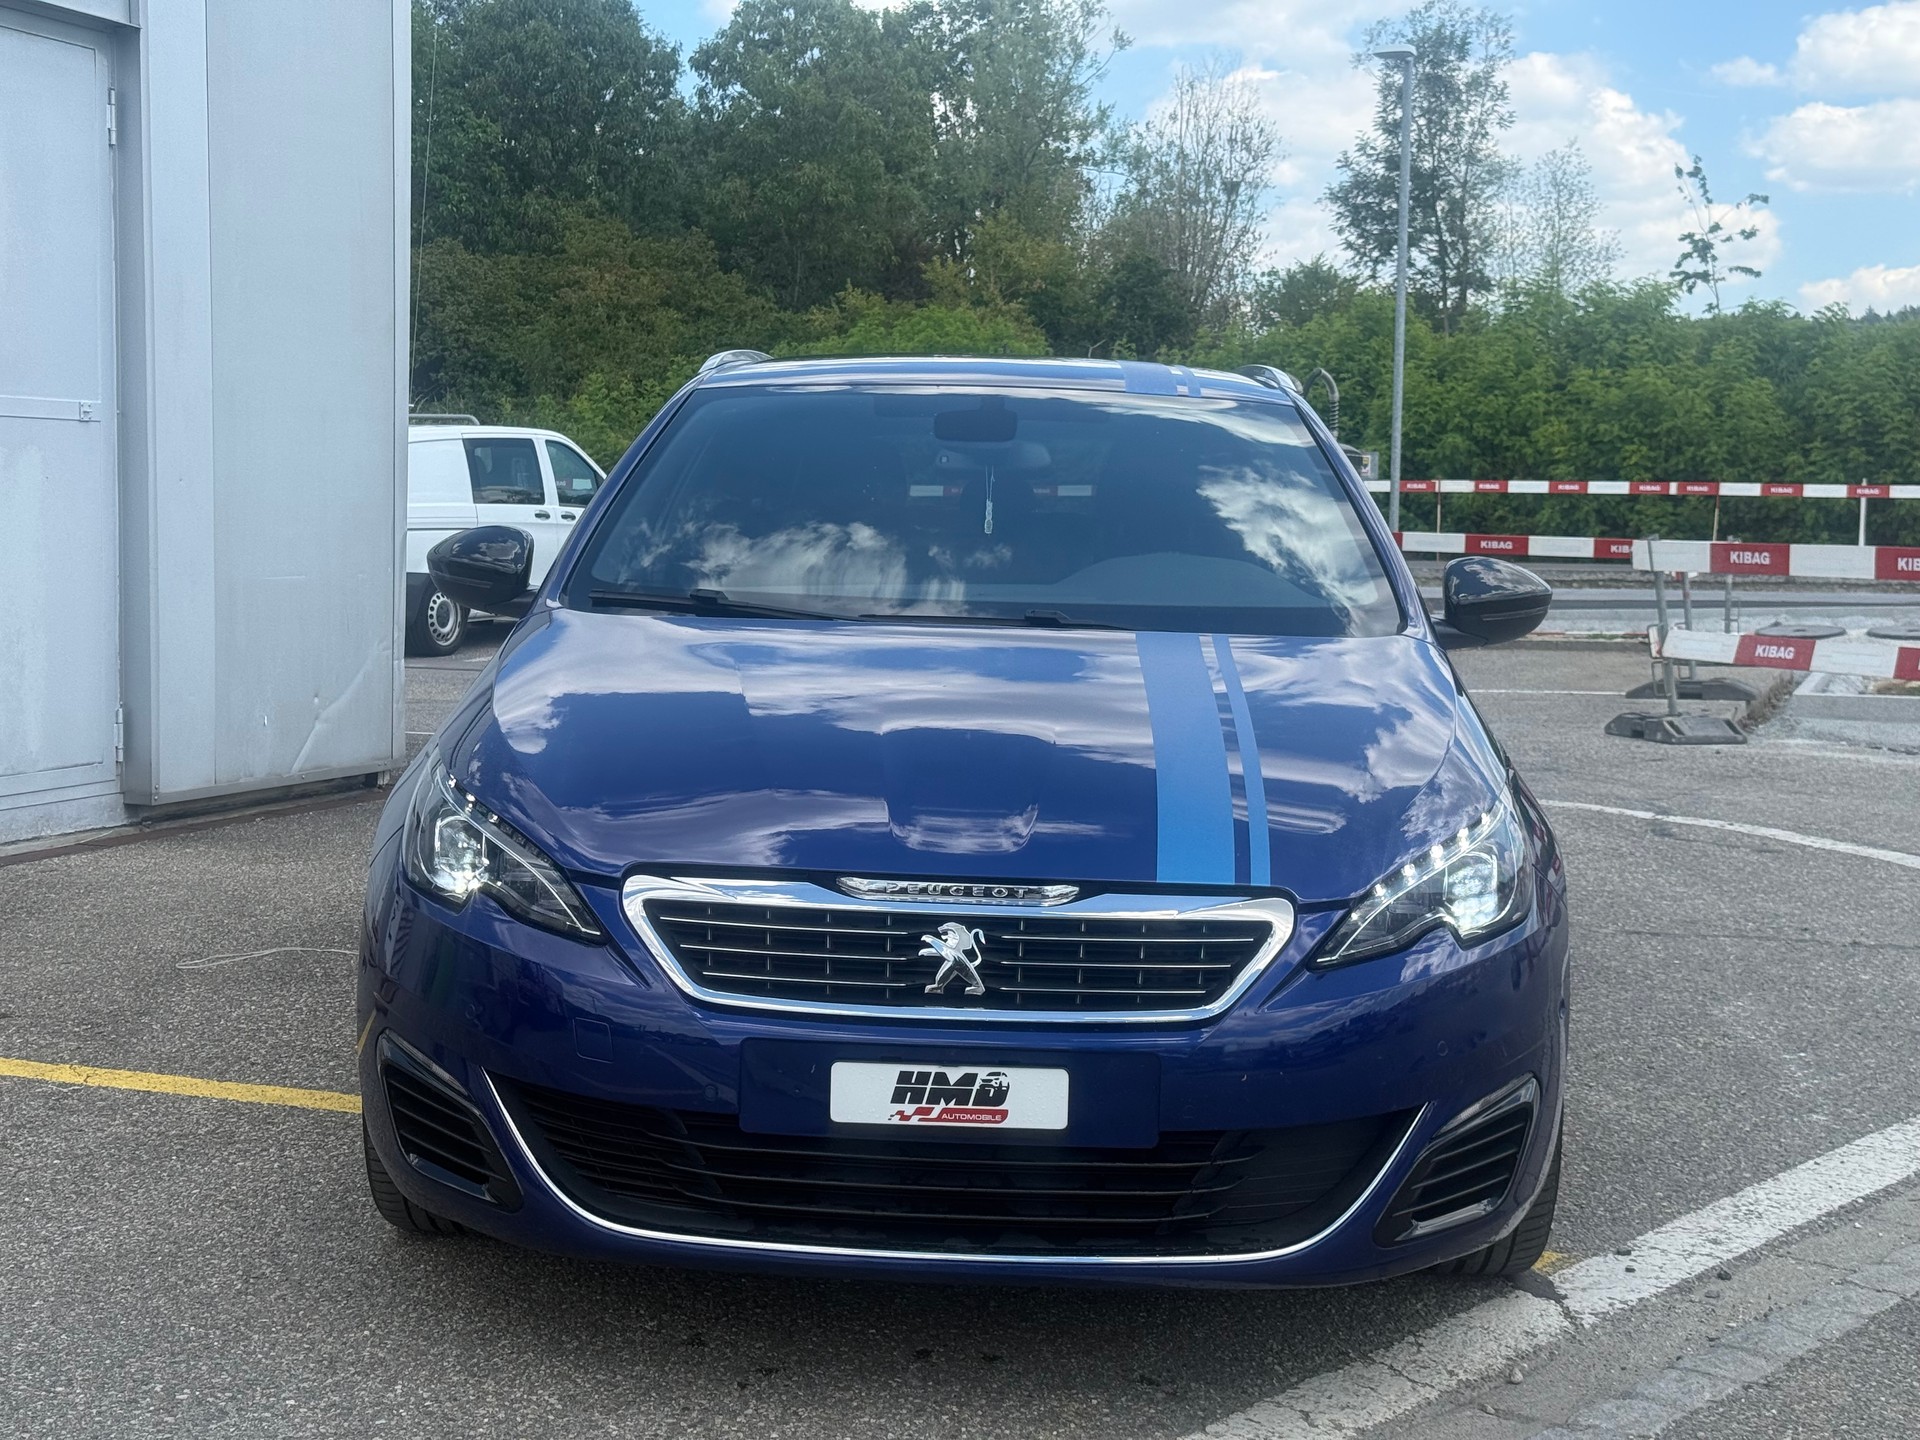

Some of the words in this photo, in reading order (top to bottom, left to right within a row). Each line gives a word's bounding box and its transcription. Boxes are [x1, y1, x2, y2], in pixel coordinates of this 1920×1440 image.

[1406, 482, 1427, 490] KIBAG
[1478, 482, 1500, 490] KIBAG
[1558, 483, 1580, 491] KIBAG
[1638, 484, 1662, 492] KIBAG
[1686, 485, 1709, 493] KIBAG
[1856, 487, 1880, 495] KIBAG
[1480, 539, 1513, 550] KIBAG
[1610, 544, 1632, 554] KIB
[1730, 550, 1770, 565] KIBAG
[1897, 557, 1920, 571] KIB
[1754, 644, 1795, 660] KIBAG
[885, 883, 1029, 899] PEUGEOT
[941, 1112, 1002, 1122] AUTOMOBILE
